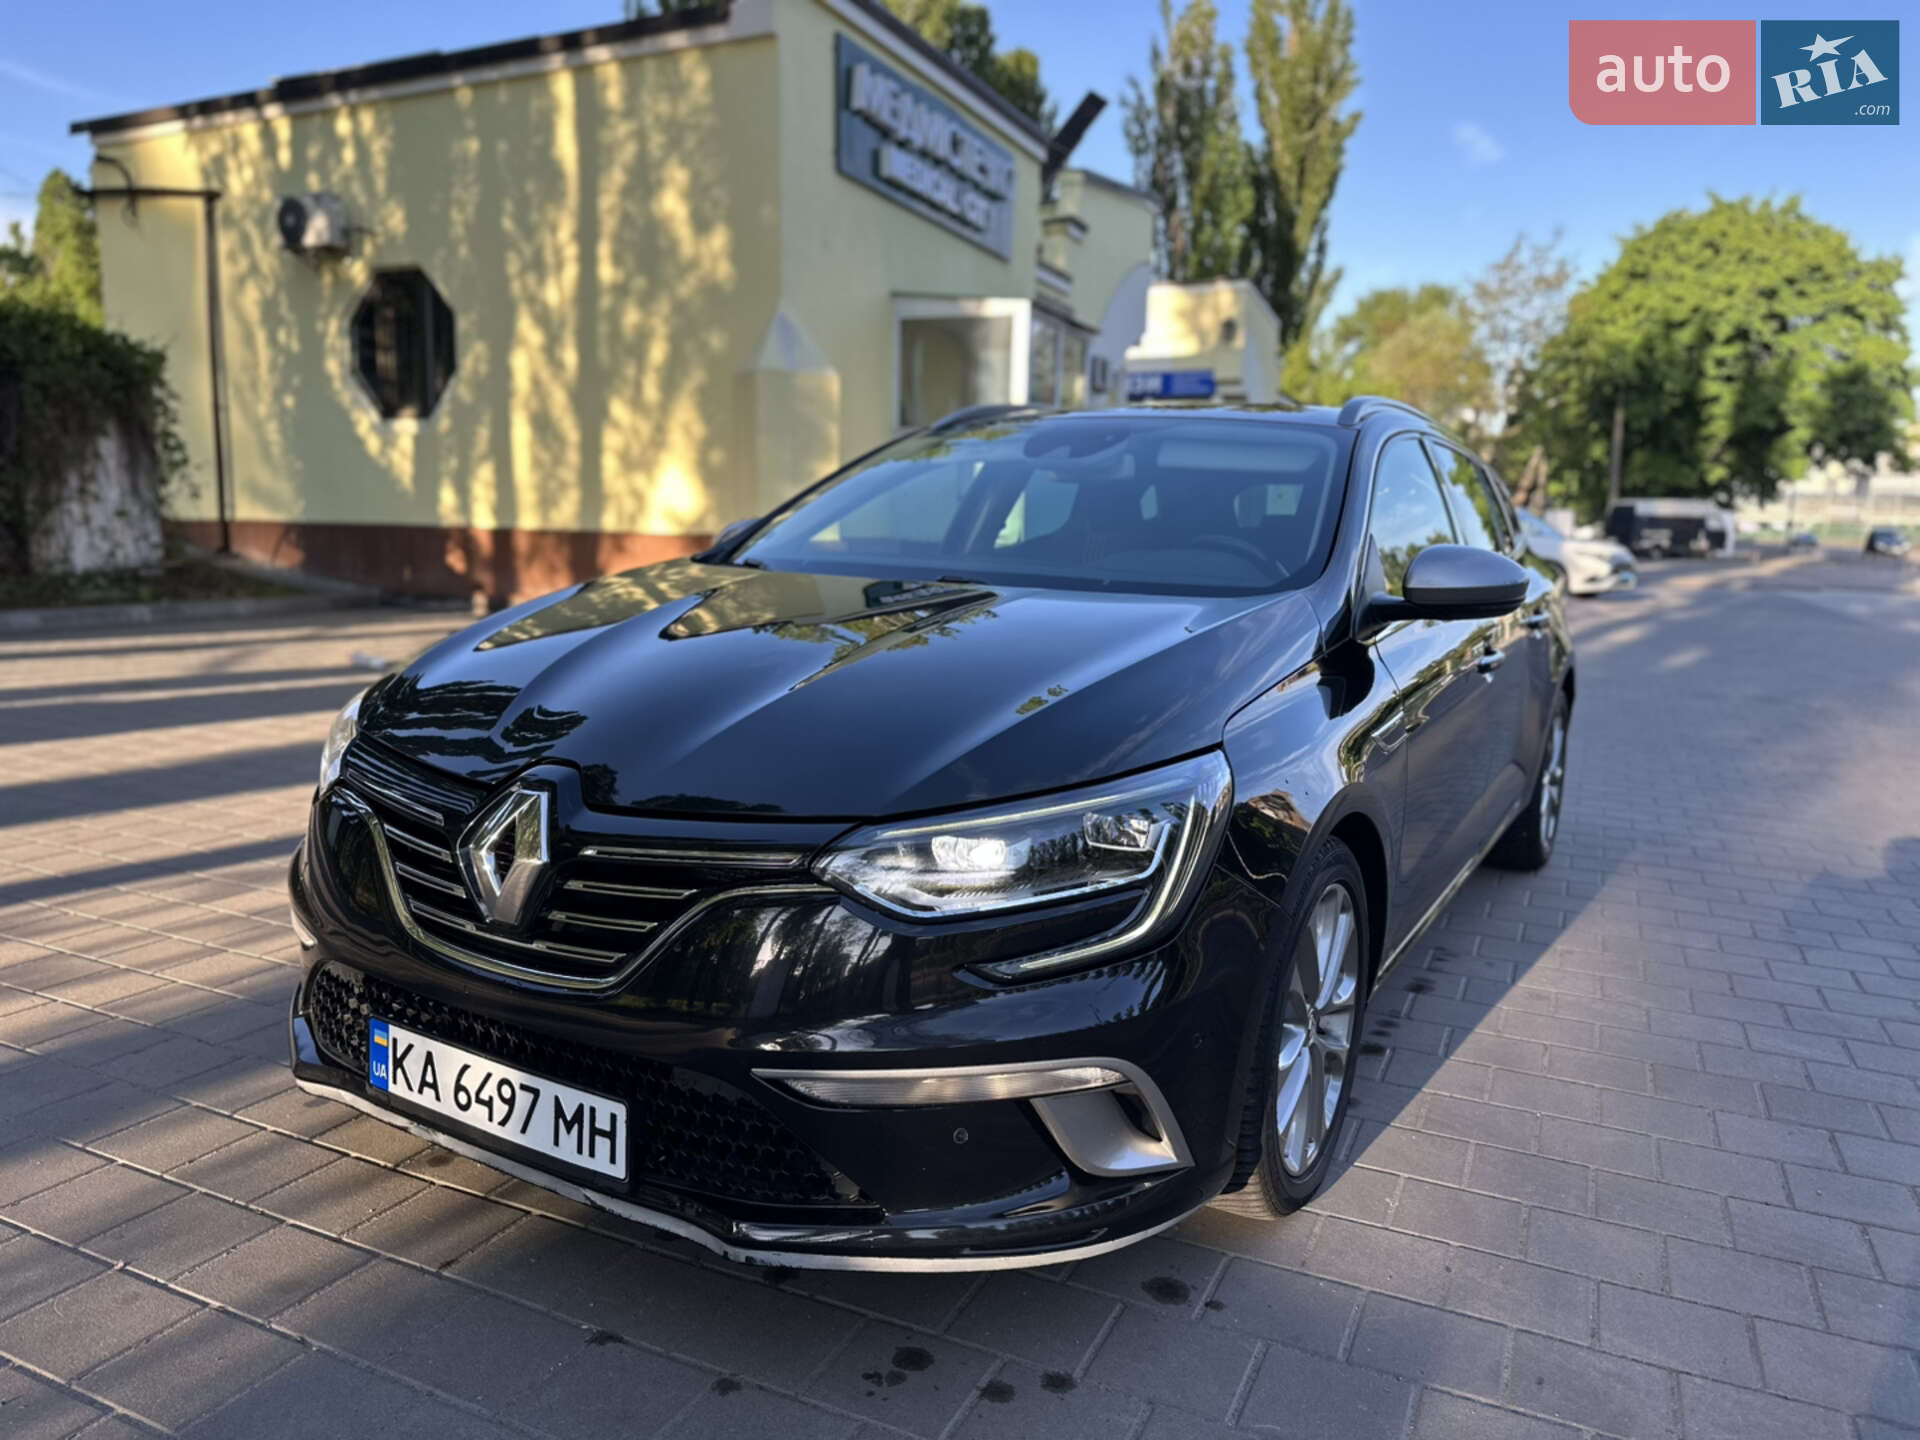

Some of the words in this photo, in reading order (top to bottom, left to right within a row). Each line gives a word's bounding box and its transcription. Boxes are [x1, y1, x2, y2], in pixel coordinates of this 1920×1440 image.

[372, 1061, 388, 1080] UA
[391, 1037, 441, 1103] KA
[453, 1063, 541, 1134] 6497
[553, 1095, 618, 1165] MH
